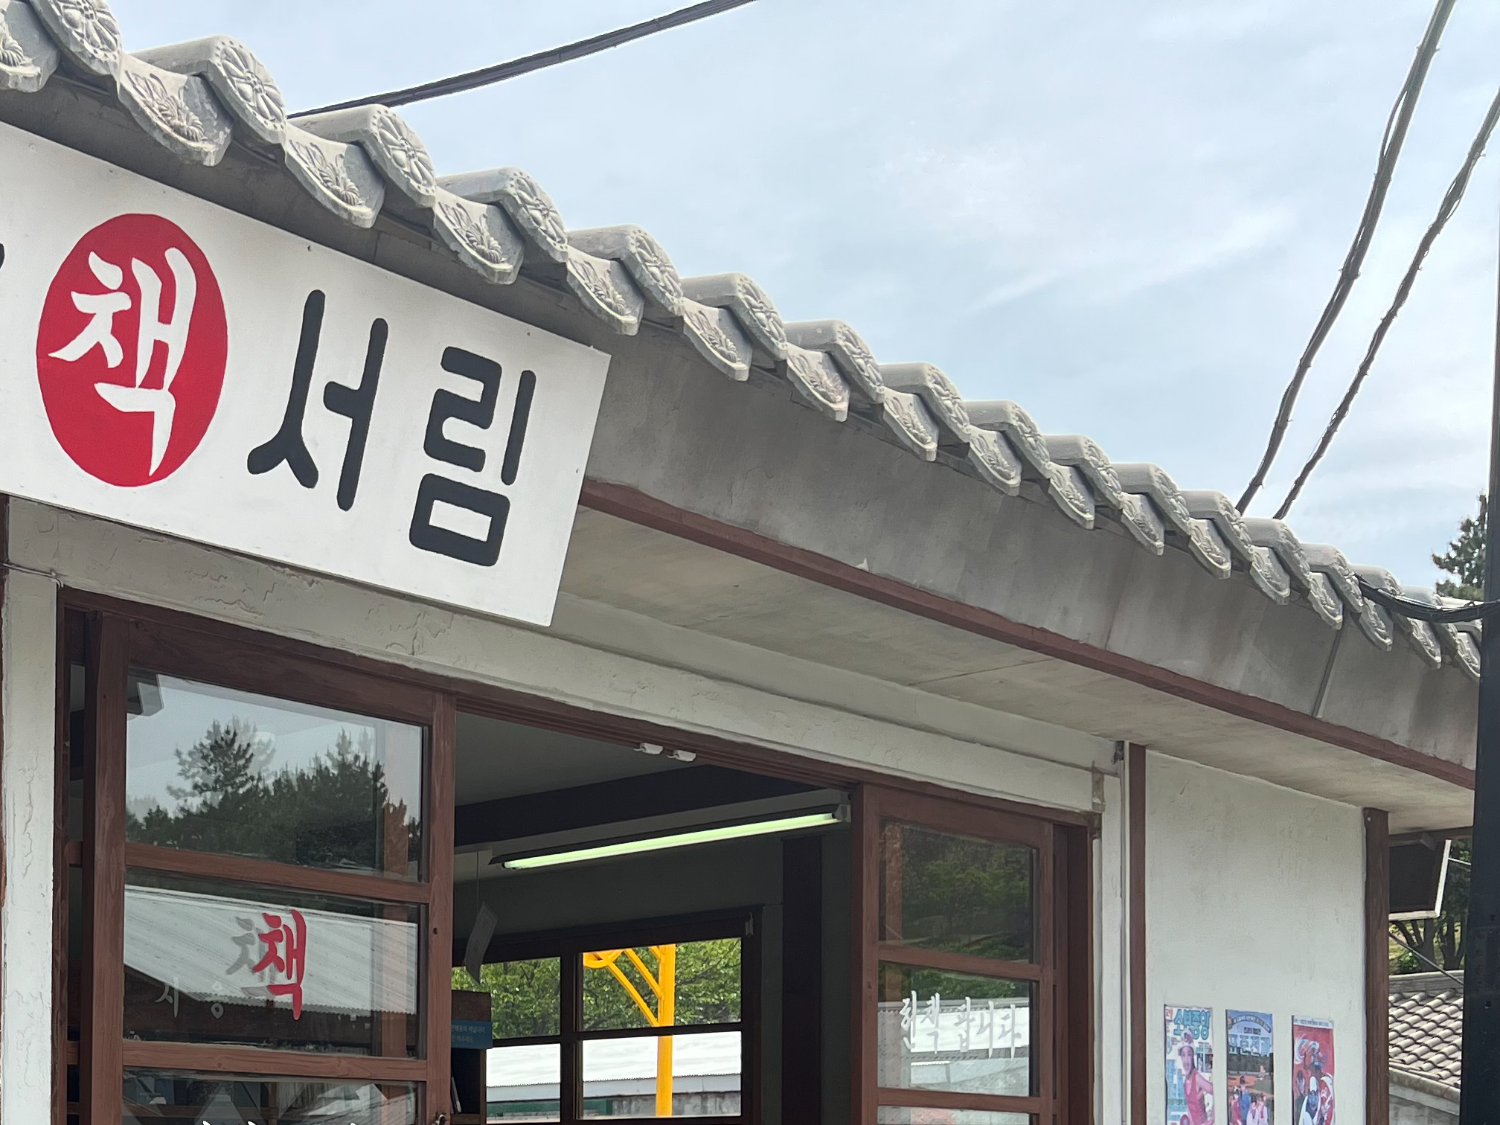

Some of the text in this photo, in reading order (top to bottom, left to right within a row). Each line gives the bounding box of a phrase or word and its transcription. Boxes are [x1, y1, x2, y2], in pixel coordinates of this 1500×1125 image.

[47, 244, 201, 479] 책
[247, 288, 538, 567] 서림
[252, 909, 307, 1021] 책
[953, 996, 1021, 1060] 팝니다
